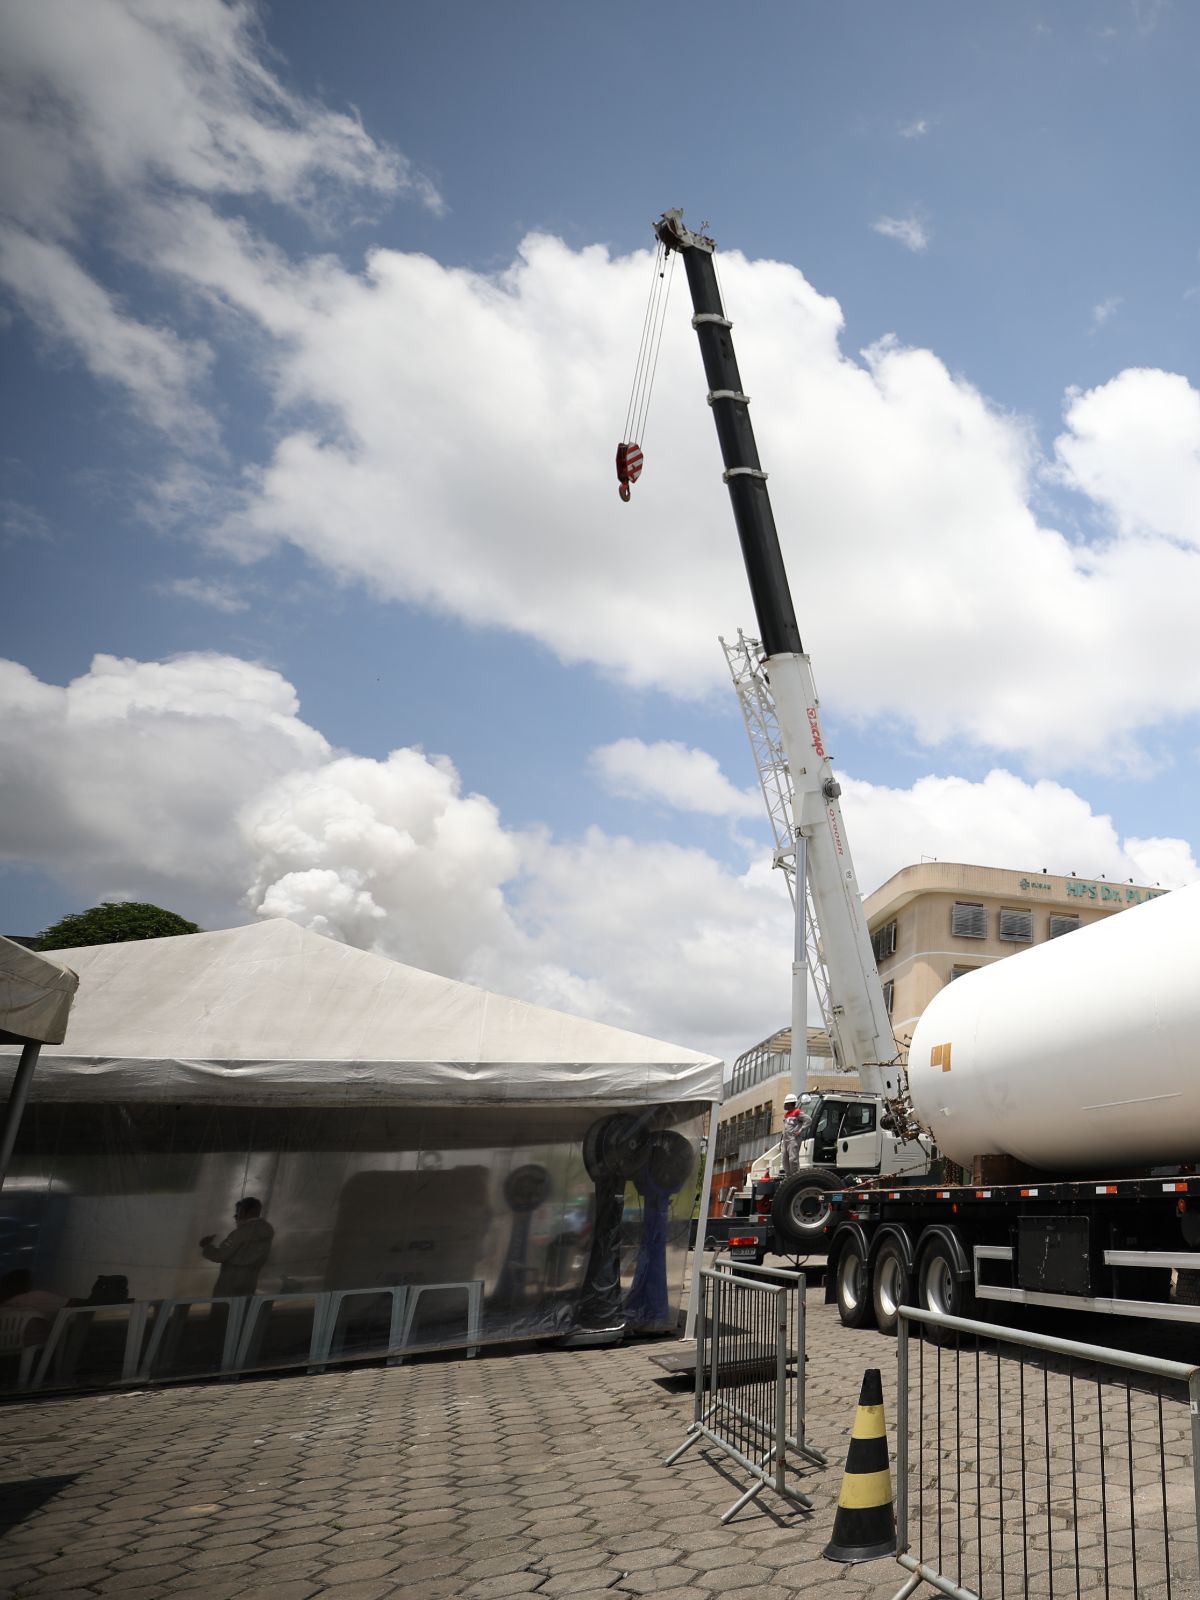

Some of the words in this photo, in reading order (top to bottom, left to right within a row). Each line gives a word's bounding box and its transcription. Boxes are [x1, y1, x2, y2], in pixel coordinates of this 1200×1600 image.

[809, 720, 824, 757] XCMG
[1066, 882, 1097, 899] HPS
[1101, 885, 1122, 903] Dr.
